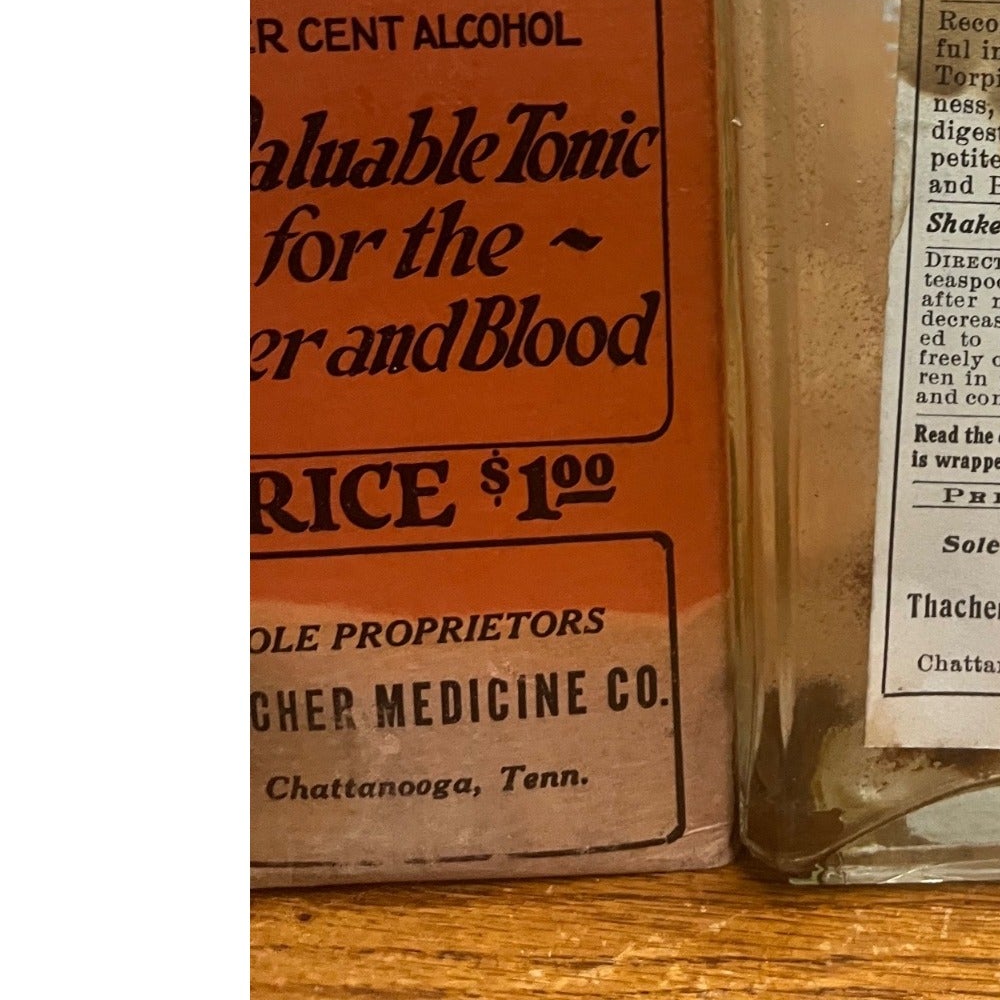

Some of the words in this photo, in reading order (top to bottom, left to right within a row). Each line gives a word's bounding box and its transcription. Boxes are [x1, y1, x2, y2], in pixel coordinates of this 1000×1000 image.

[298, 15, 404, 51] CENT
[413, 10, 583, 50] ALCOHOL
[936, 38, 970, 59] ful
[934, 98, 994, 120] ness,
[495, 102, 660, 183] Tonic
[929, 175, 974, 194] and
[253, 203, 388, 287] for
[393, 200, 525, 280] the
[922, 291, 977, 308] after
[326, 299, 468, 377] and
[459, 290, 661, 372] Blood
[920, 330, 945, 346] ed
[961, 331, 981, 347] to
[920, 349, 984, 370] freely
[919, 372, 954, 385] ren
[965, 370, 987, 386] in
[916, 389, 958, 404] and
[914, 424, 958, 443] Read
[965, 425, 993, 444] the
[911, 450, 927, 467] is
[942, 535, 1000, 554] Sole
[331, 607, 606, 650] PROPRIETORS
[374, 670, 588, 729] MEDICINE
[606, 664, 670, 712] CO.
[265, 775, 482, 800] Chattanooga,
[501, 764, 589, 793] Tenn.
